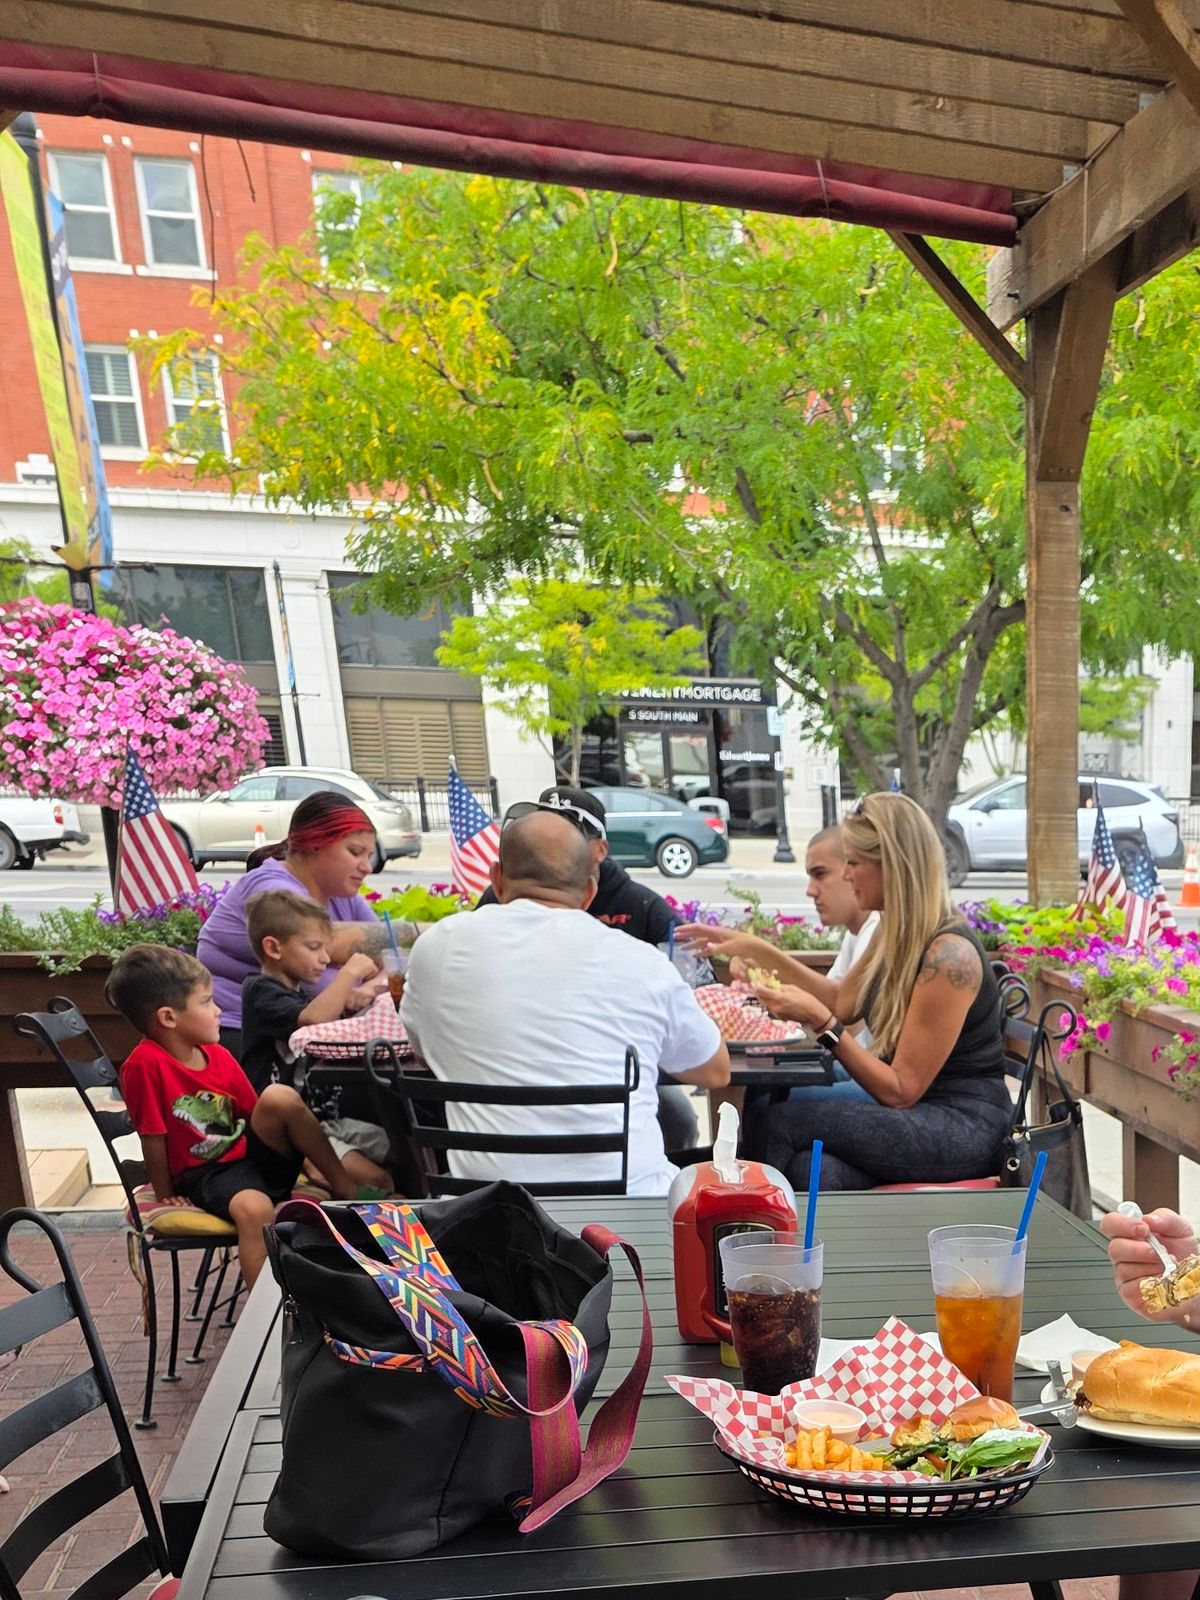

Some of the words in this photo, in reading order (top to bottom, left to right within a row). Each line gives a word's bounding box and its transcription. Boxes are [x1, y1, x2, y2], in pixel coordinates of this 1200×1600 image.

[681, 686, 762, 702] MORTGAGE
[637, 709, 671, 721] SOUTH
[672, 711, 698, 722] MAIN
